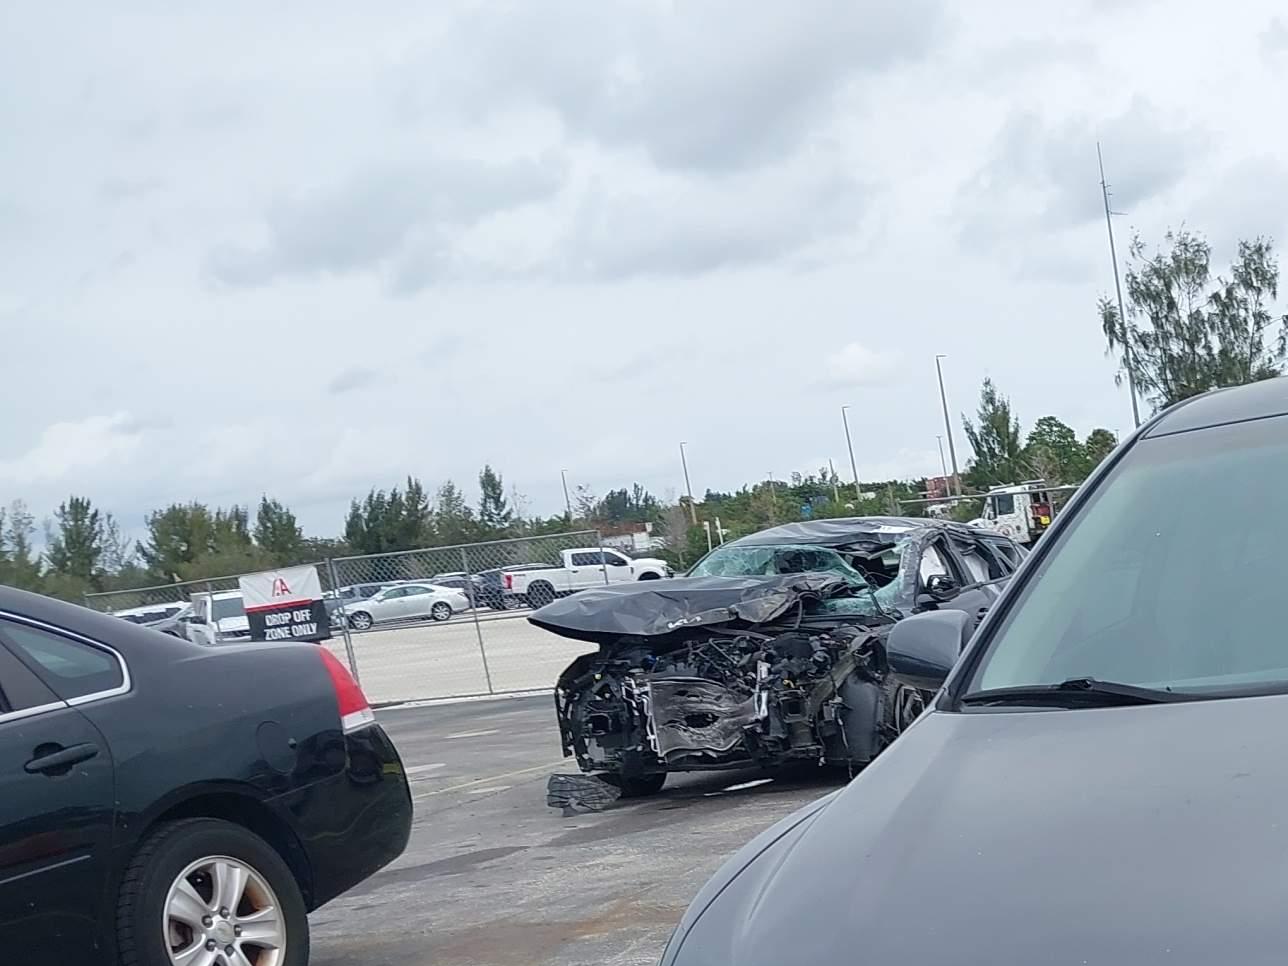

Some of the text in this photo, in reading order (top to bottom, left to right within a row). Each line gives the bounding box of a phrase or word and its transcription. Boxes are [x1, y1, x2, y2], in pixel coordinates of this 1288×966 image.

[265, 609, 312, 626] DROP OFF
[264, 622, 318, 640] ZONE ONLY
